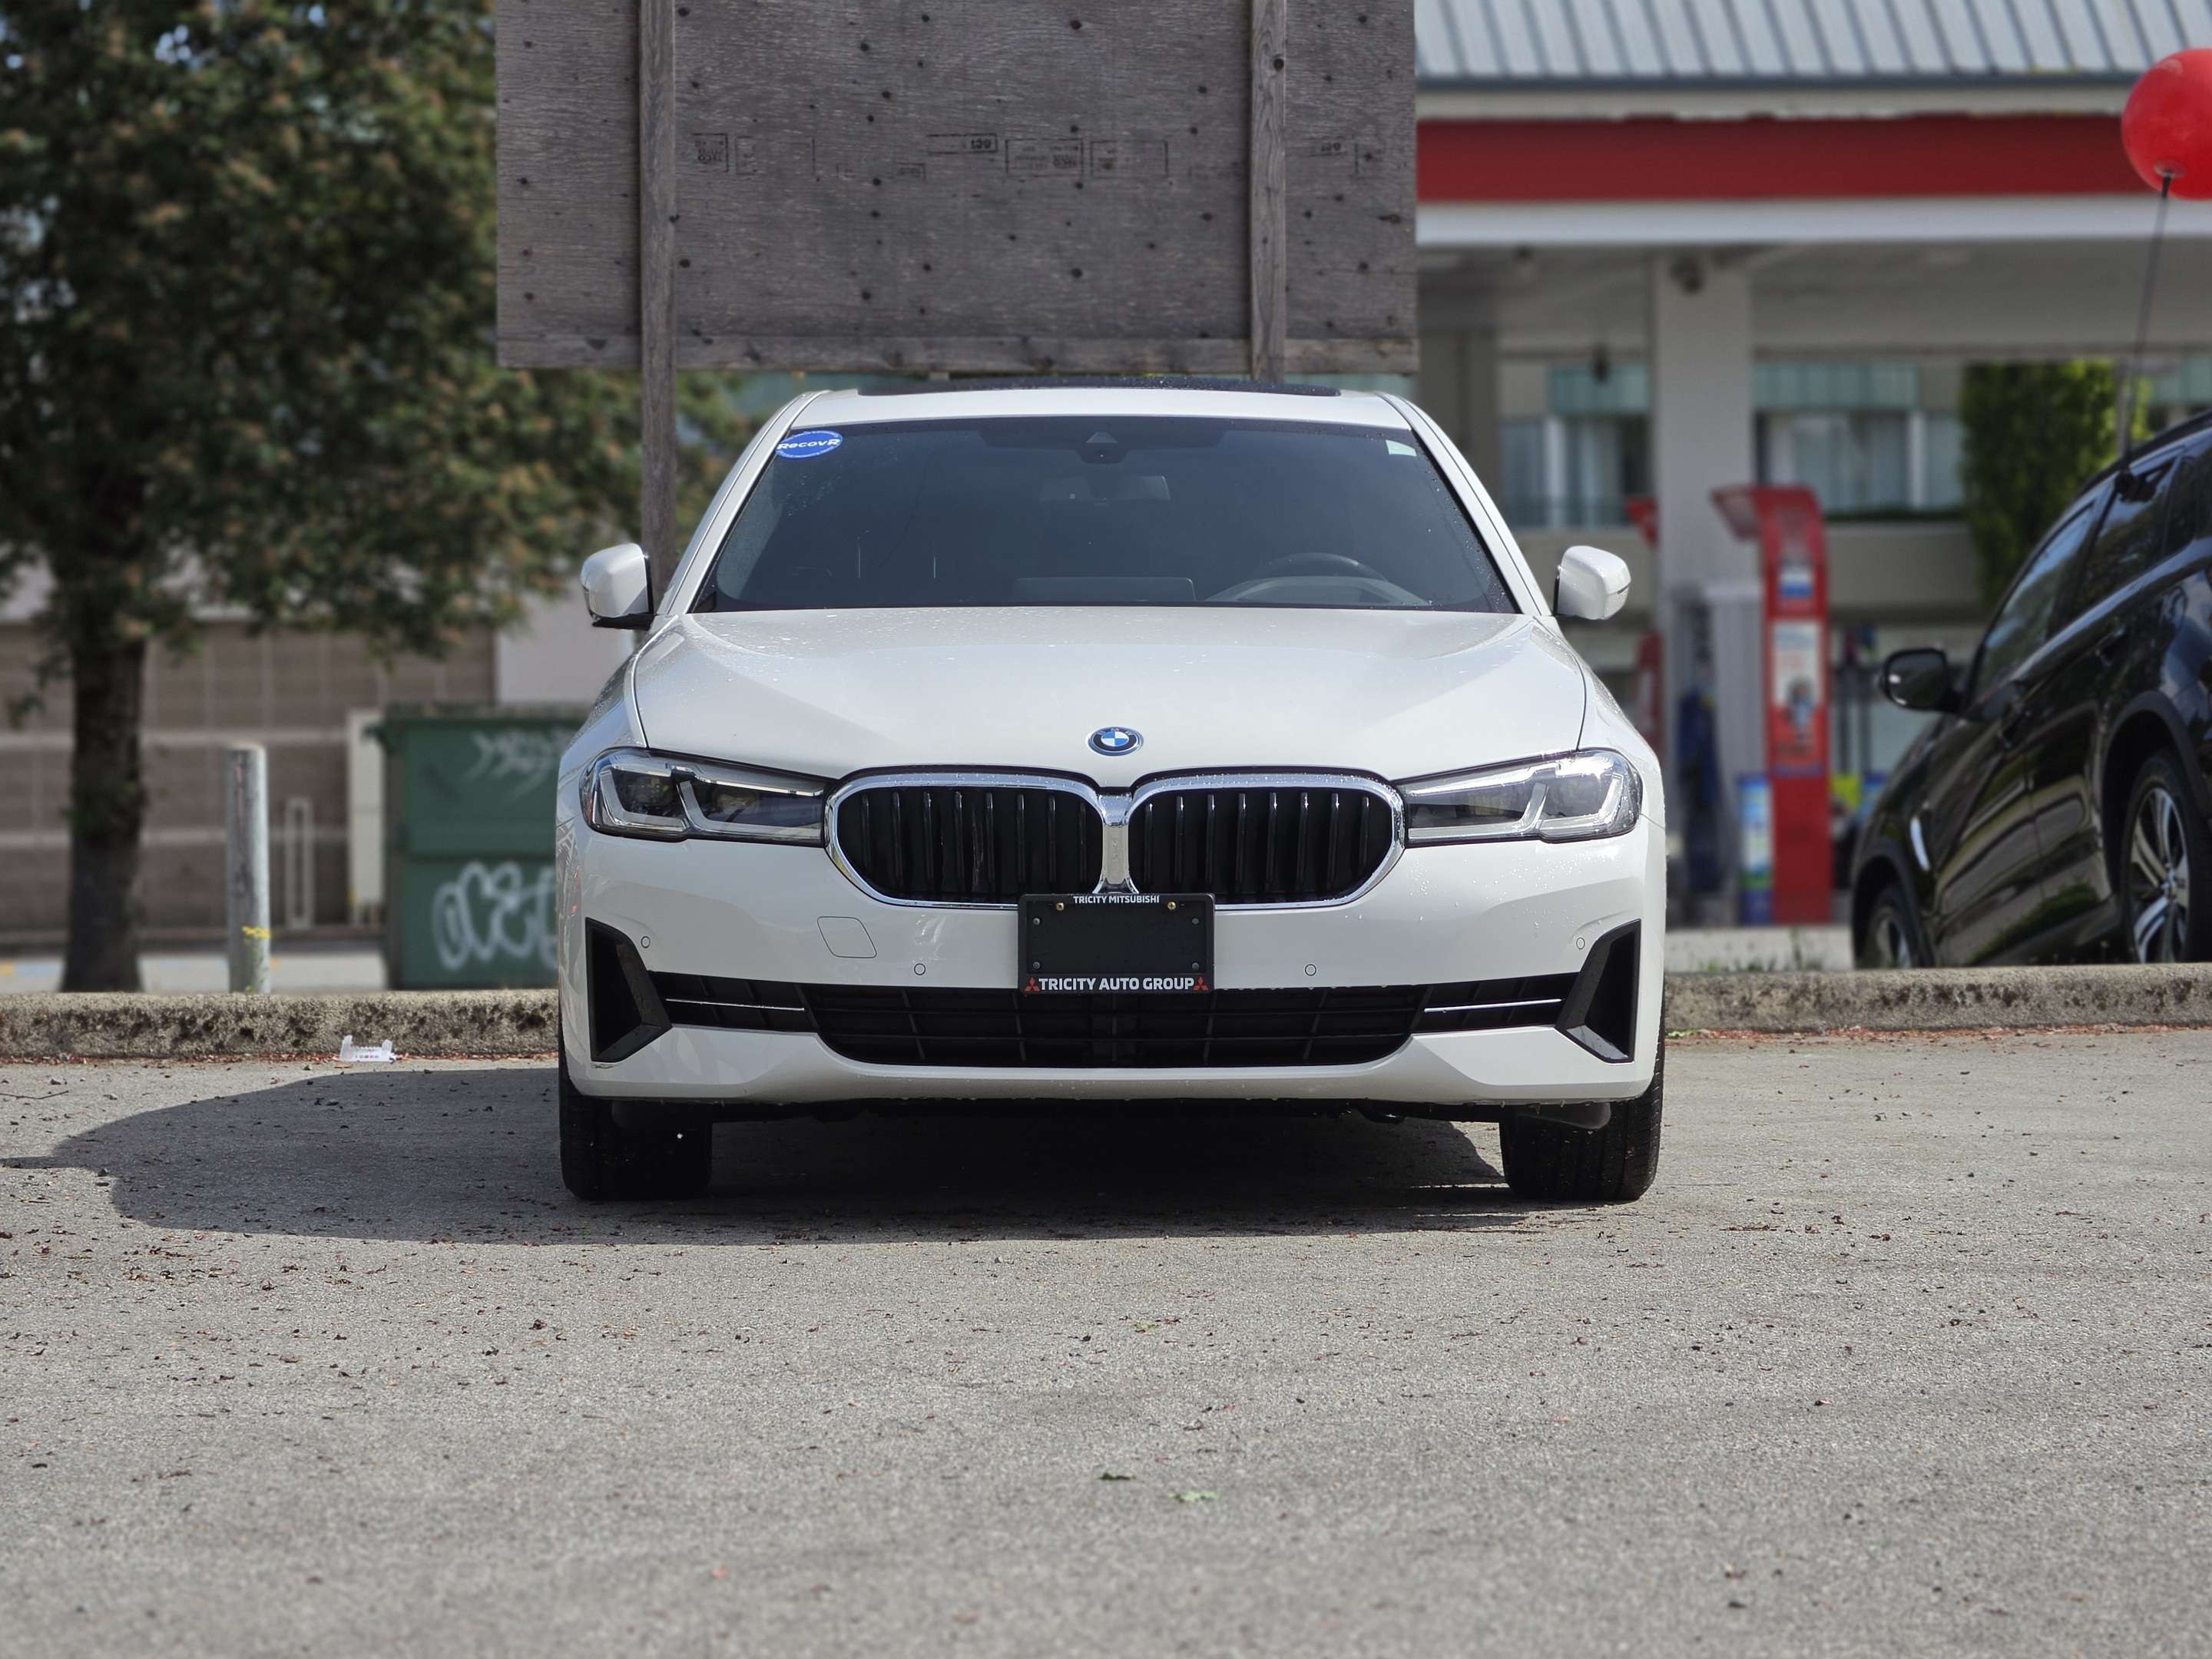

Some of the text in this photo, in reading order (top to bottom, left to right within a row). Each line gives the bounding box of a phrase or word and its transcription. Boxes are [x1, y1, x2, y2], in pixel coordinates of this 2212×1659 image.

[1073, 895, 1160, 904] TRICITY MITSUBISHI
[1038, 977, 1195, 991] TRICITY AUTO GROUP
